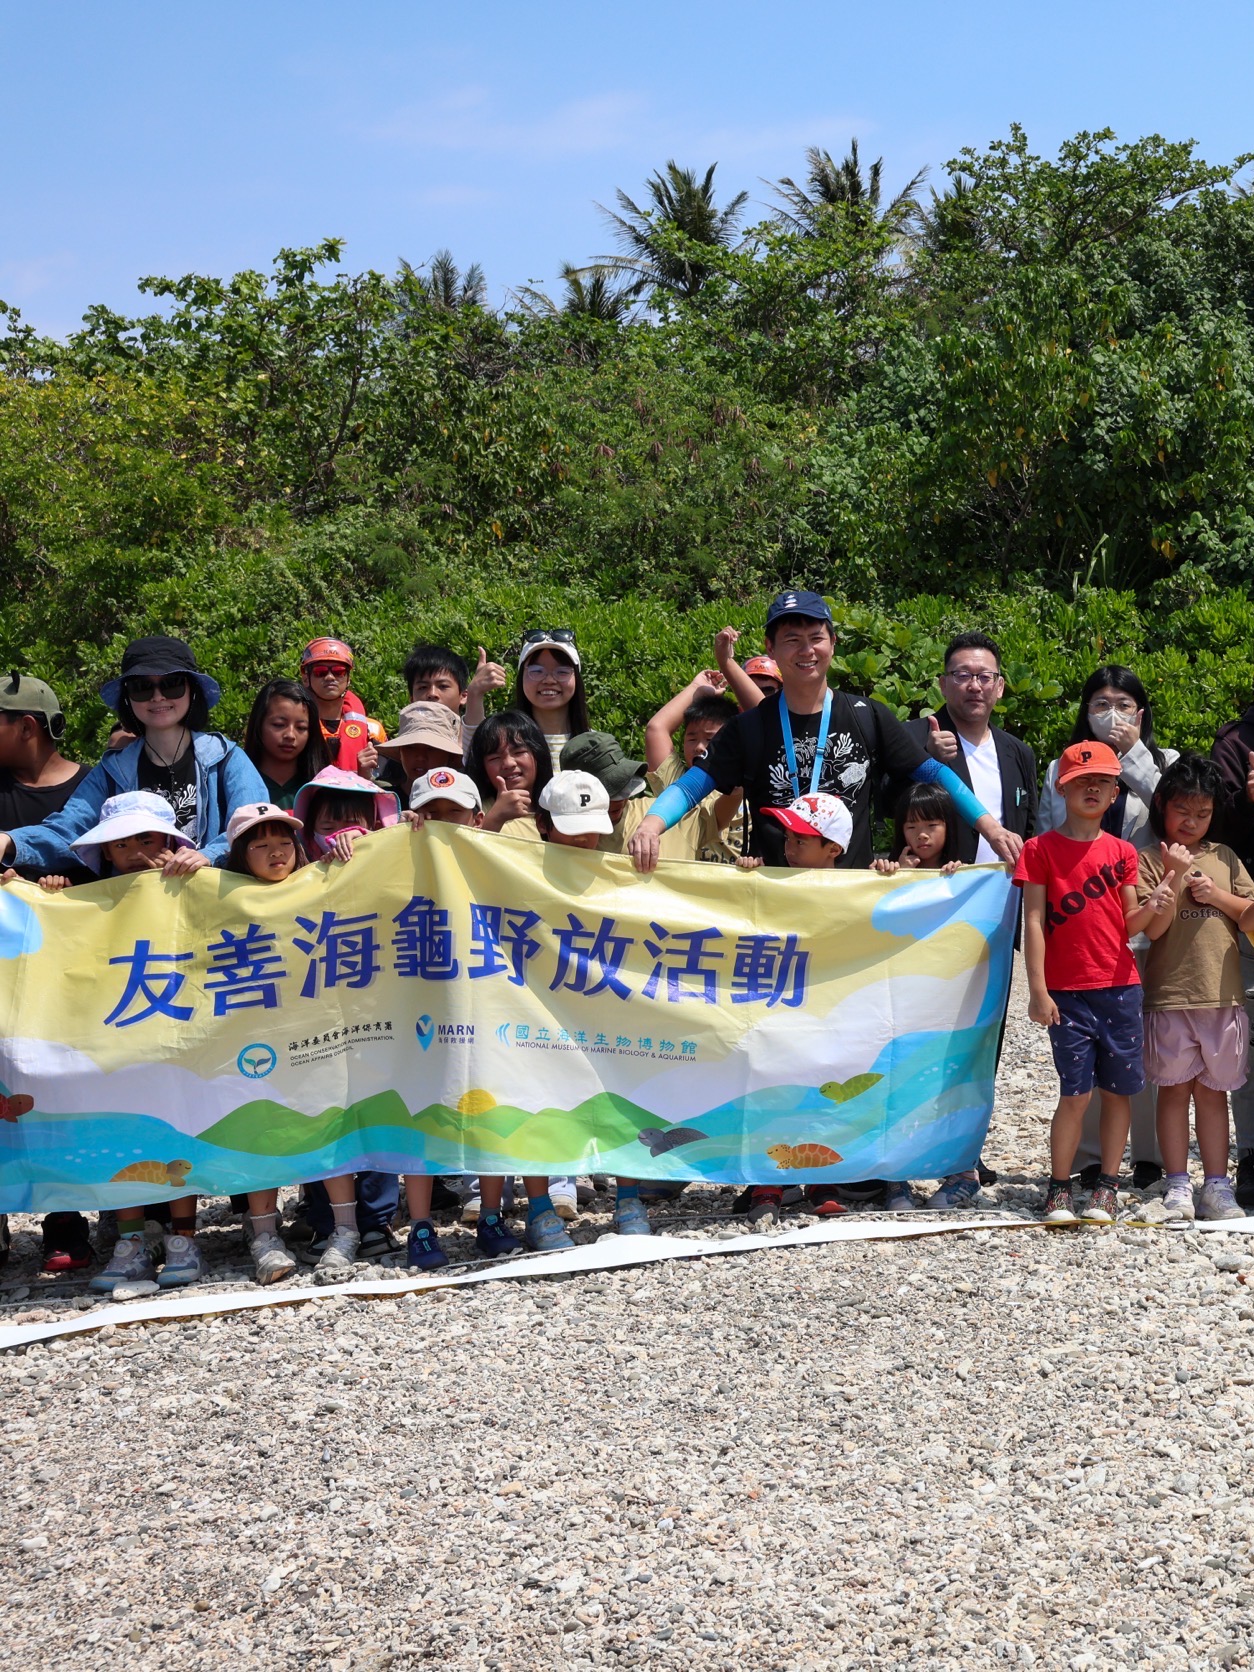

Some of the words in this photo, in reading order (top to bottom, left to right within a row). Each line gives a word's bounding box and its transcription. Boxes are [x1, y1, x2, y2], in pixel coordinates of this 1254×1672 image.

[1081, 751, 1092, 763] P
[580, 793, 591, 807] P
[256, 805, 269, 816] P
[103, 895, 810, 1028] 友善海龜野放活動
[288, 1021, 393, 1051] 海洋委員會海洋保育署
[438, 1024, 475, 1035] MARN
[516, 1024, 697, 1055] 國立海洋生物博物館
[290, 1052, 310, 1061] OCEAN
[310, 1041, 347, 1056] CONSERVATION
[516, 1041, 549, 1050] NATIONAL
[591, 1046, 616, 1054] MARINE
[618, 1048, 650, 1058] BIOLOGY
[658, 1053, 697, 1062] AQUARIUM
[290, 1058, 310, 1067] OCEAN
[311, 1053, 333, 1062] AFFAIRS
